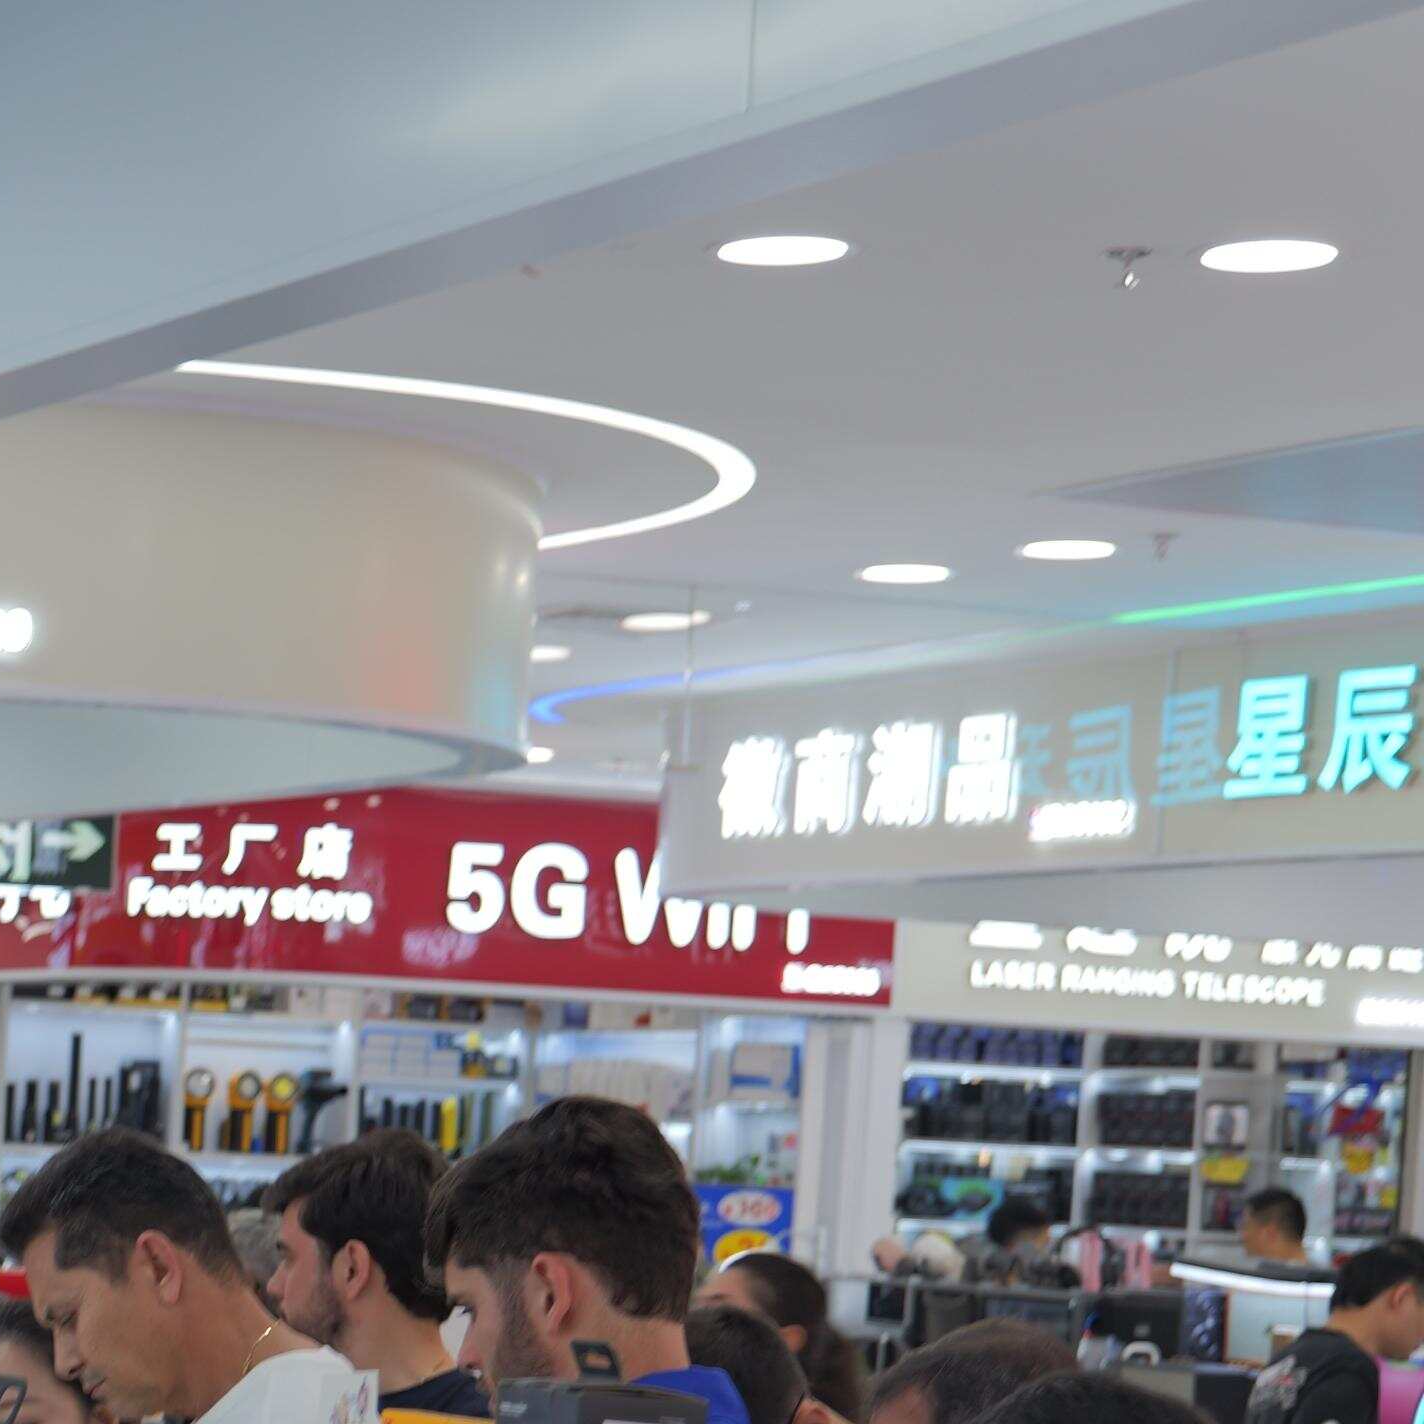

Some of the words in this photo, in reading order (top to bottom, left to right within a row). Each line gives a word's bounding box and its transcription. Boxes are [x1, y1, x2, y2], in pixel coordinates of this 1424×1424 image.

[1222, 664, 1418, 799] 星辰
[151, 822, 354, 881] 工厂店
[127, 876, 271, 927] Factory
[271, 884, 374, 926] store
[445, 841, 589, 940] 5G
[970, 958, 1056, 992] LASER
[1060, 963, 1177, 998] RANGING
[1182, 970, 1327, 1008] TELESCOPE
